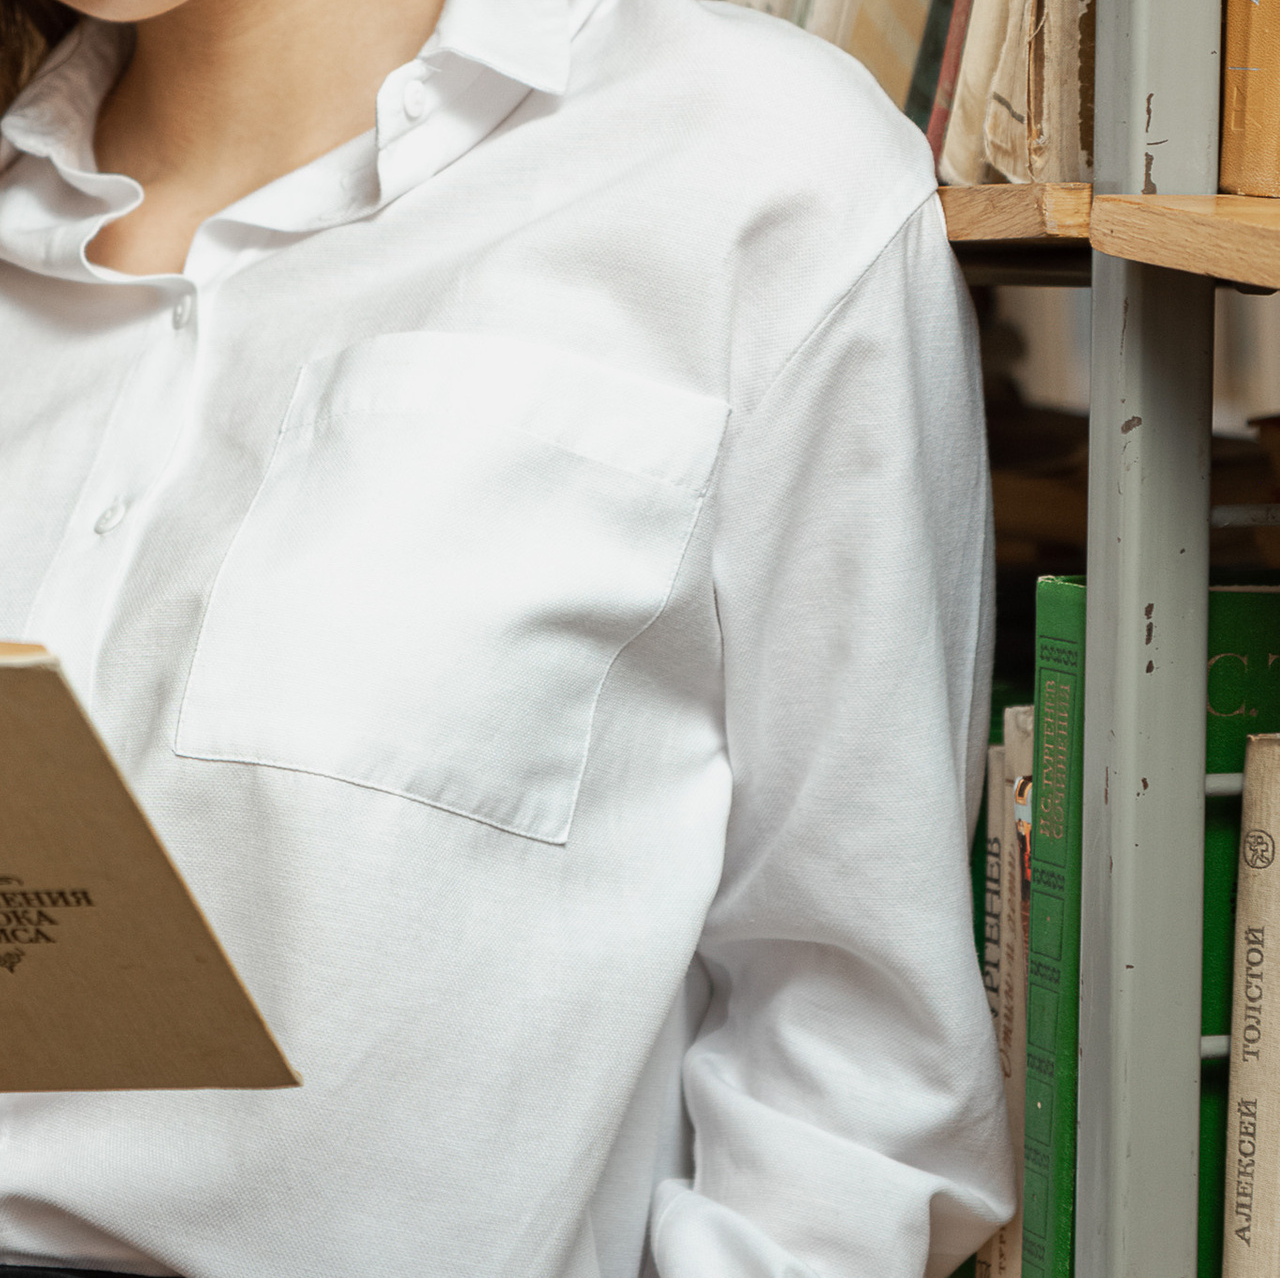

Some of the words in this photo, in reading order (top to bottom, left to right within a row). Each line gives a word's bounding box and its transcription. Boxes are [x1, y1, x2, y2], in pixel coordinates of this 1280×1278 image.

[1053, 684, 1071, 841] СОЧИНЕНИЯ
[1242, 925, 1265, 1063] ТОЛСТОЙ
[1234, 1097, 1257, 1248] АЛЕКСЕЙ
